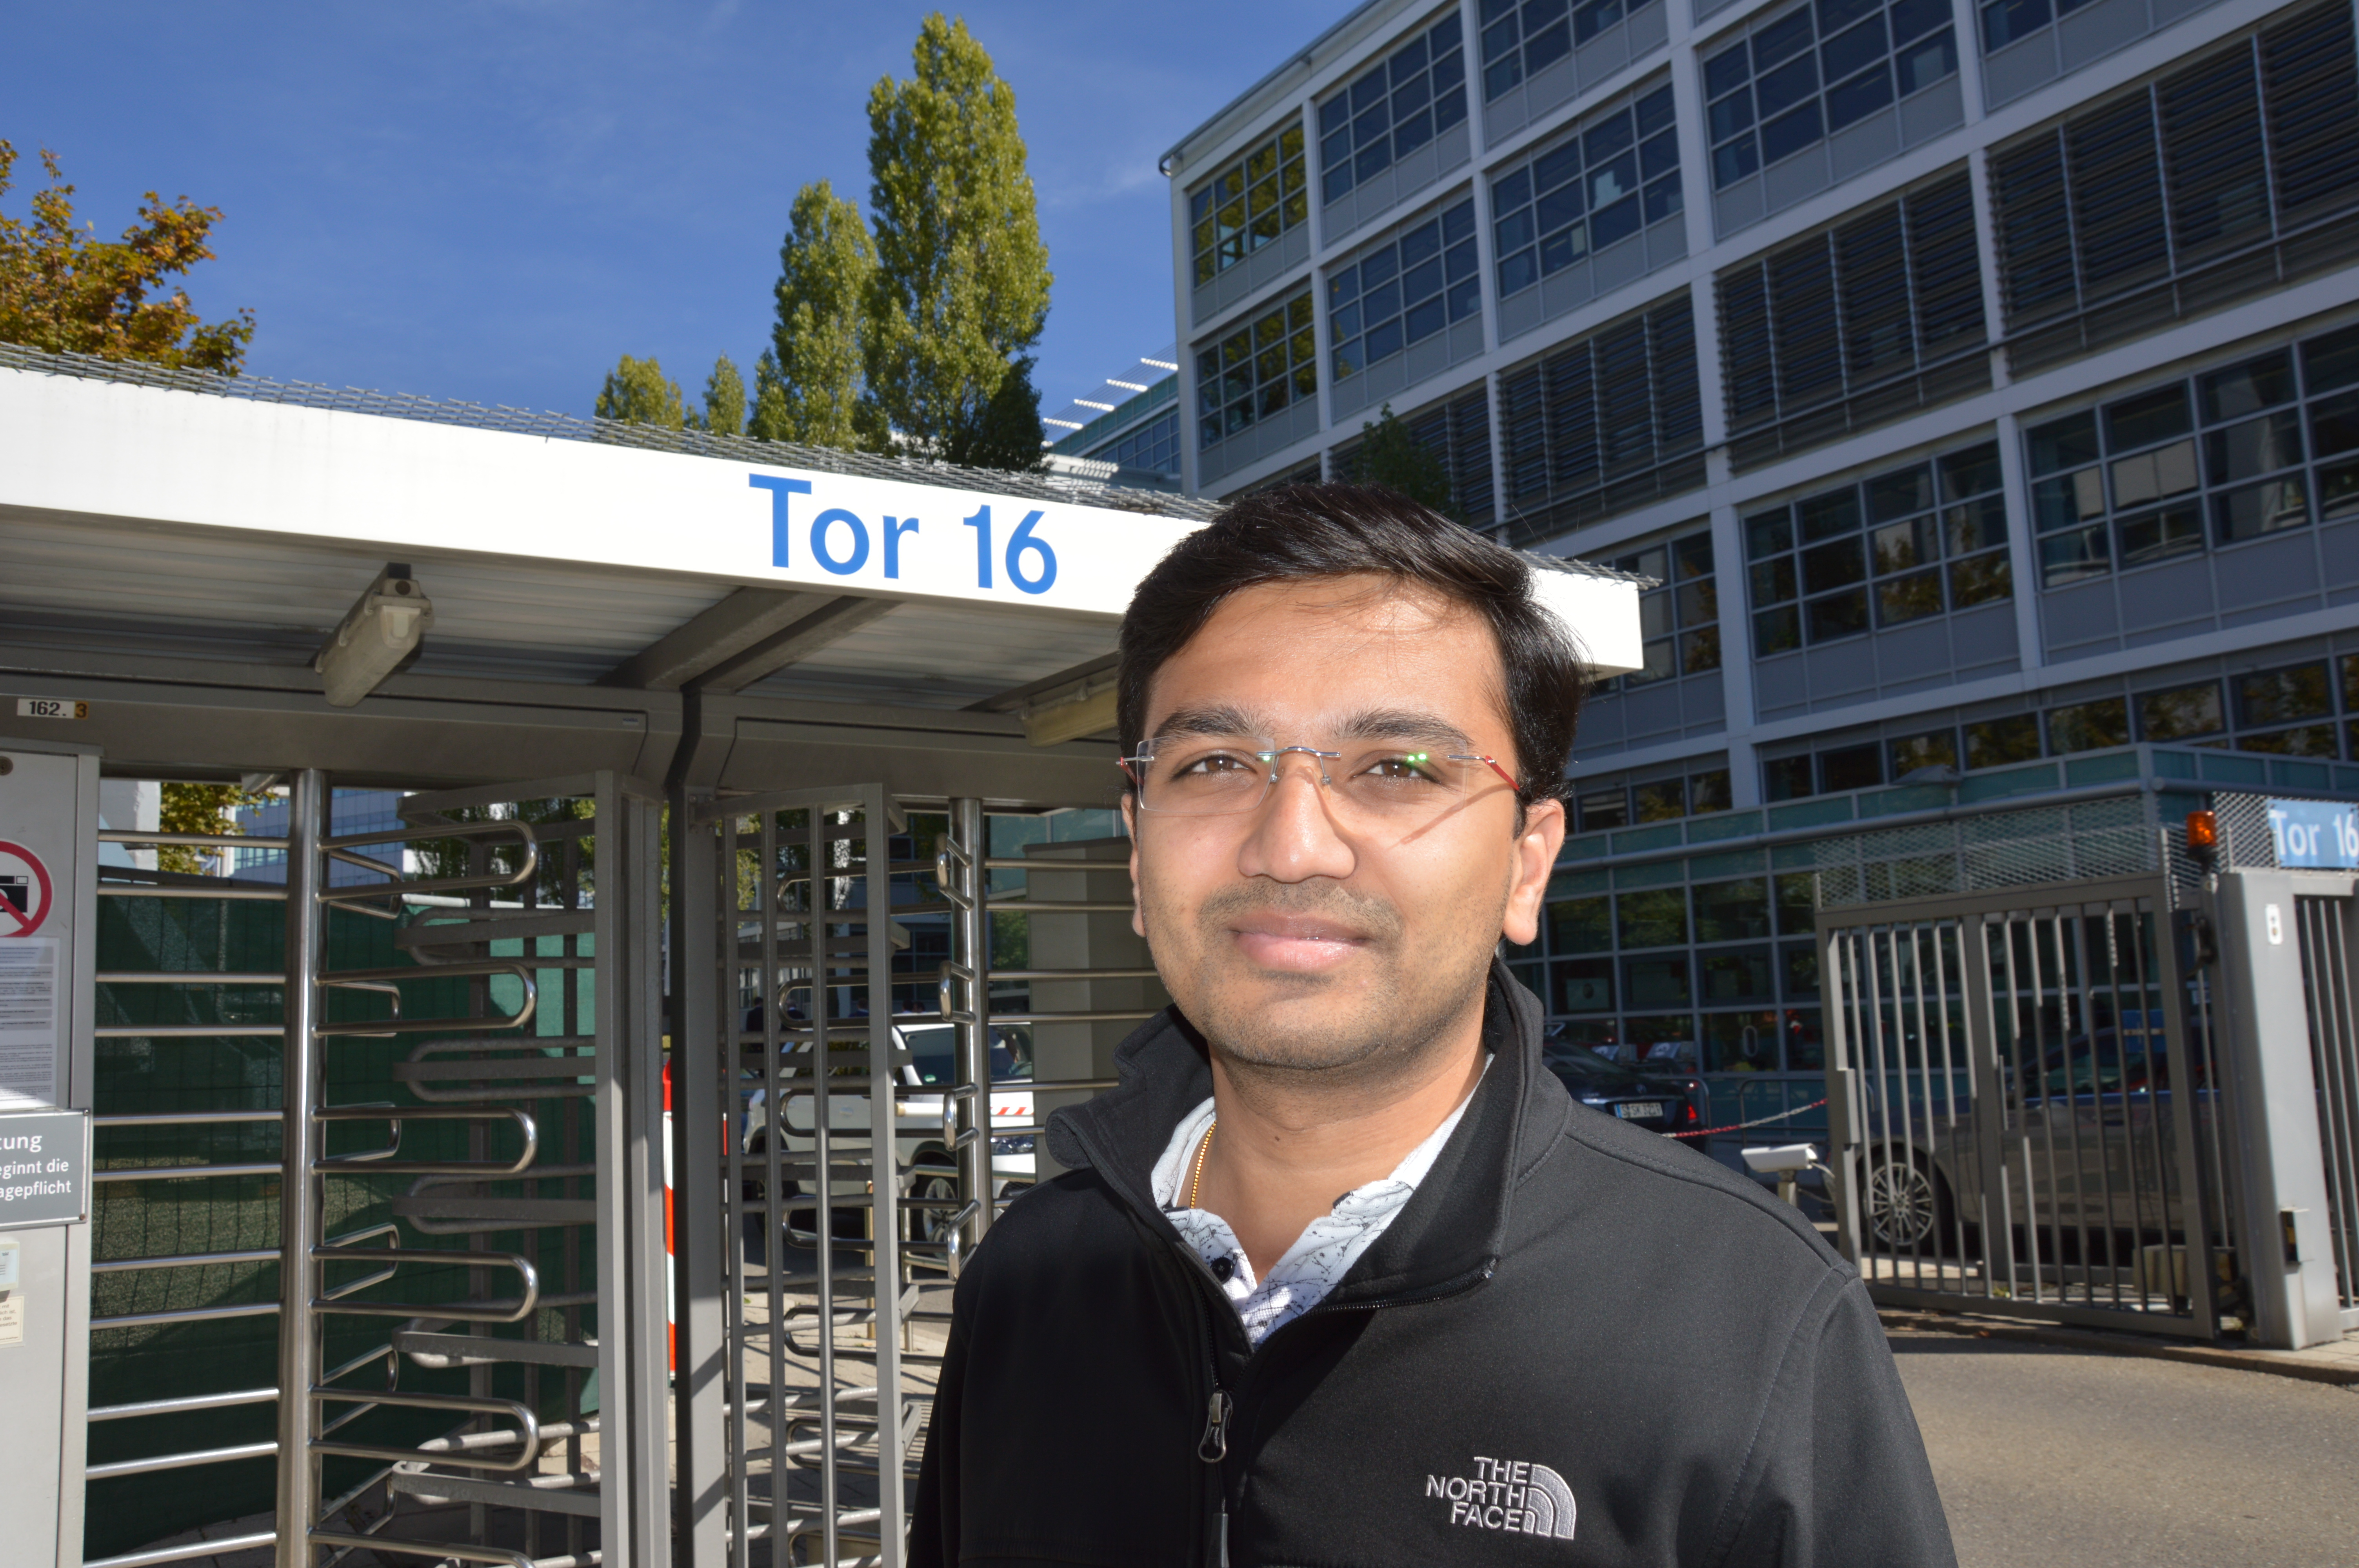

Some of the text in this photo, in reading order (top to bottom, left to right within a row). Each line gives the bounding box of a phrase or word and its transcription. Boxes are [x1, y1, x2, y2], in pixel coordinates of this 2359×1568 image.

[749, 473, 1057, 594] Tor 16
[2268, 809, 2359, 858] Tor 16
[0, 1135, 42, 1153] ung
[46, 1158, 69, 1173] die
[1474, 1456, 1529, 1485] THE
[1425, 1474, 1525, 1508] NORTH
[1450, 1501, 1523, 1532] FACE
